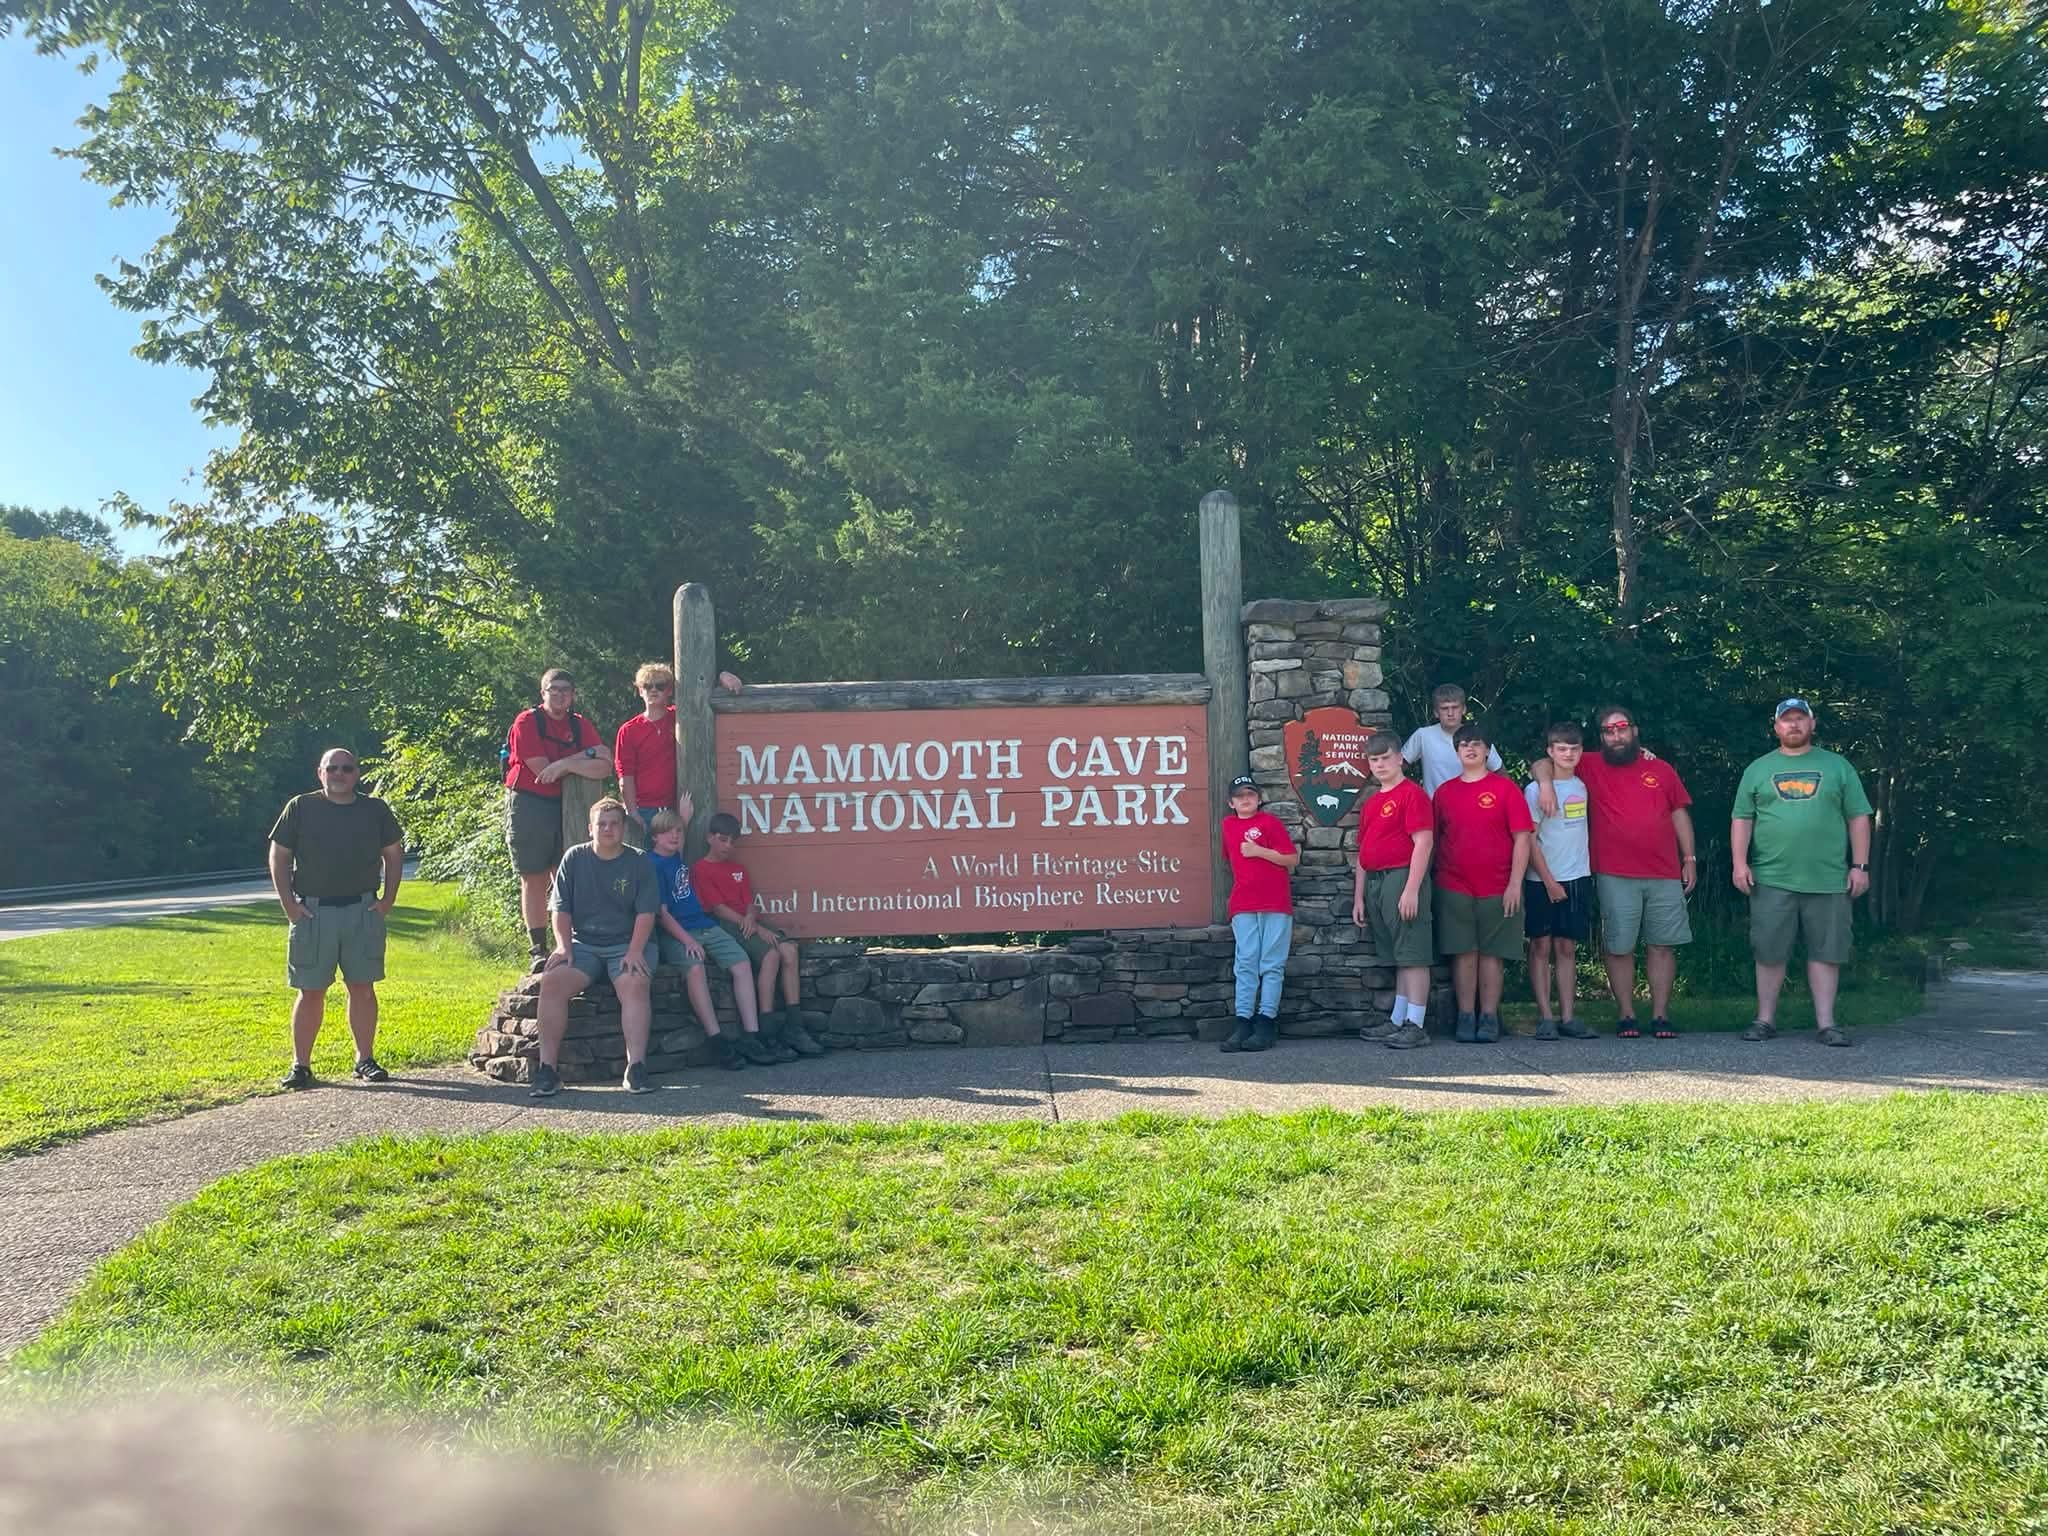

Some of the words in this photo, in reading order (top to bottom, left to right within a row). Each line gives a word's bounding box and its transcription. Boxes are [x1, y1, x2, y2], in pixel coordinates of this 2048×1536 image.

[736, 739, 1023, 785] MAMMOTH
[1047, 735, 1188, 779] CAVE
[1333, 742, 1360, 751] PARK
[737, 788, 1016, 835] NATIONAL
[1040, 783, 1190, 827] PARK
[922, 855, 940, 879] A
[951, 852, 1019, 878] World
[1032, 852, 1128, 880] Heritage
[1137, 850, 1181, 874] Site
[753, 889, 798, 914] And
[811, 883, 962, 913] International
[975, 884, 1084, 912] Biosphere
[1096, 881, 1181, 906] Reserve
